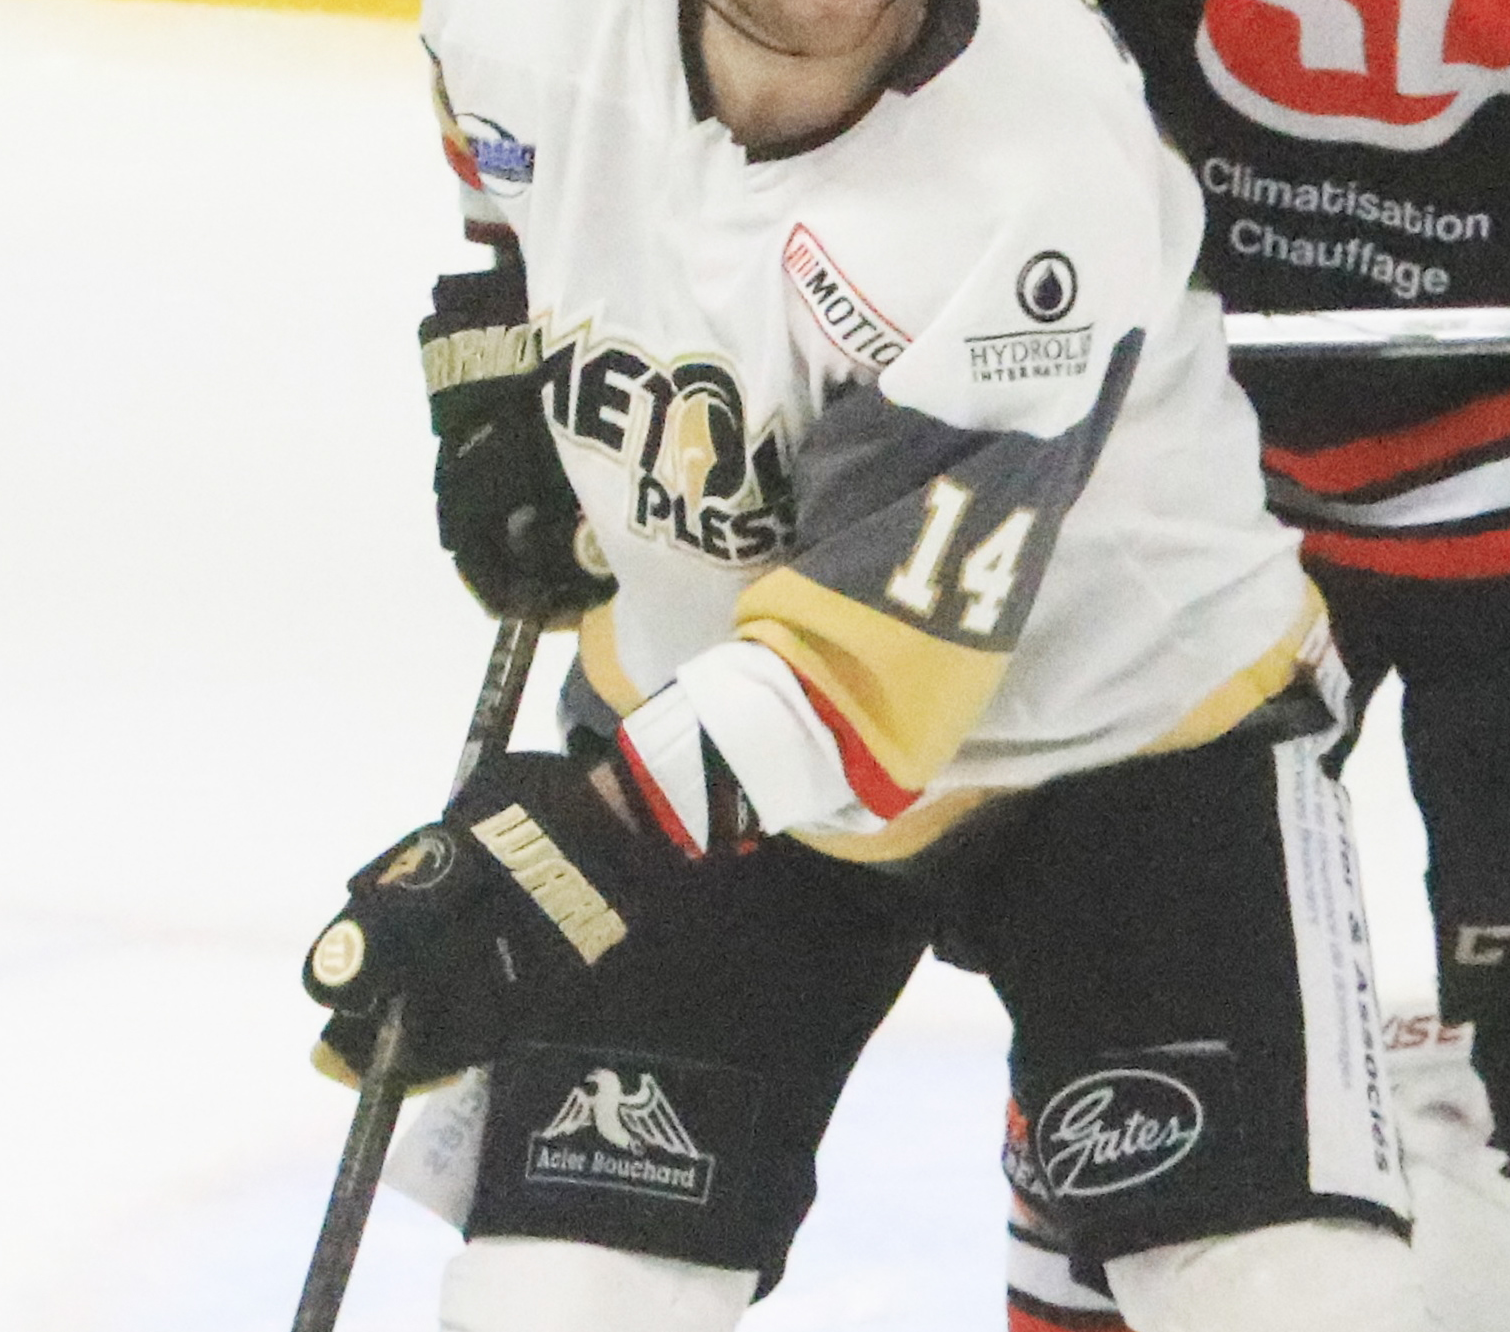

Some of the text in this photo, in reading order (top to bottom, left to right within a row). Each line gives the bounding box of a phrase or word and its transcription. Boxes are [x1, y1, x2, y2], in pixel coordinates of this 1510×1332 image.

[1199, 156, 1491, 244] Climatisation
[1230, 218, 1452, 300] Chauffage
[804, 268, 905, 368] MOTIO
[635, 475, 791, 562] PLES
[887, 478, 1036, 634] 14
[589, 1151, 696, 1190] Bouchard
[1046, 1085, 1196, 1196] Gates
